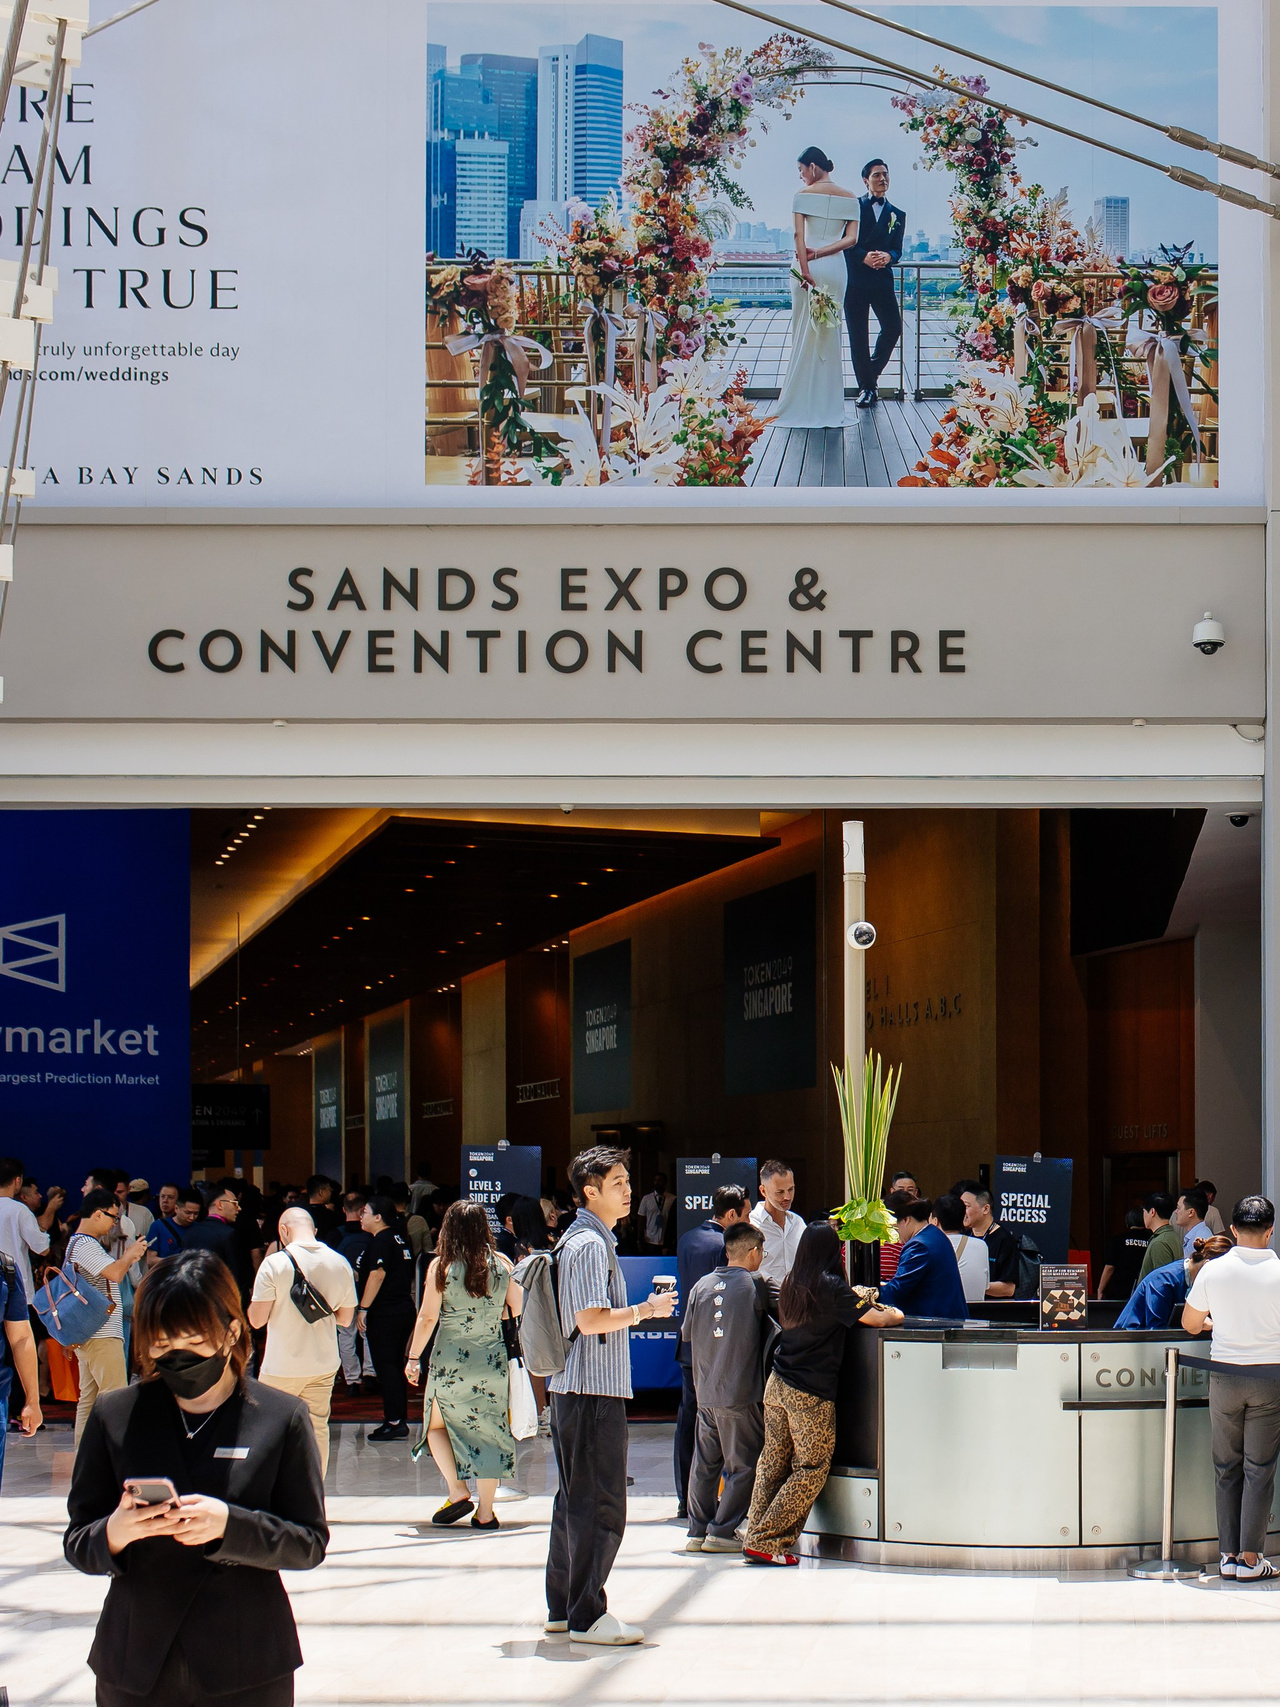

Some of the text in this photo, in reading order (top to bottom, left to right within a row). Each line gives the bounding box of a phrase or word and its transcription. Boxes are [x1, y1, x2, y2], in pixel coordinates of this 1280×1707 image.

[73, 269, 239, 309] TRUE
[83, 341, 203, 360] unforgettable
[209, 343, 240, 361] day
[78, 466, 139, 485] BAY
[157, 466, 265, 485] SANDS
[287, 567, 828, 612] SANDS EXPO &
[147, 629, 967, 674] CONVENTION CENTRE
[743, 982, 793, 1021] SINGAPORE
[880, 1000, 919, 1028] HALLS
[0, 1019, 159, 1056] market
[585, 1024, 617, 1054] SINGAPORE
[45, 1072, 112, 1084] Prediction
[115, 1074, 160, 1085] Market
[1143, 1123, 1169, 1139] LIFTS
[469, 1180, 501, 1191] LEVEL 3
[469, 1193, 489, 1204] SIDE
[1000, 1192, 1051, 1209] SPECIAL
[1000, 1207, 1047, 1224] ACCESS
